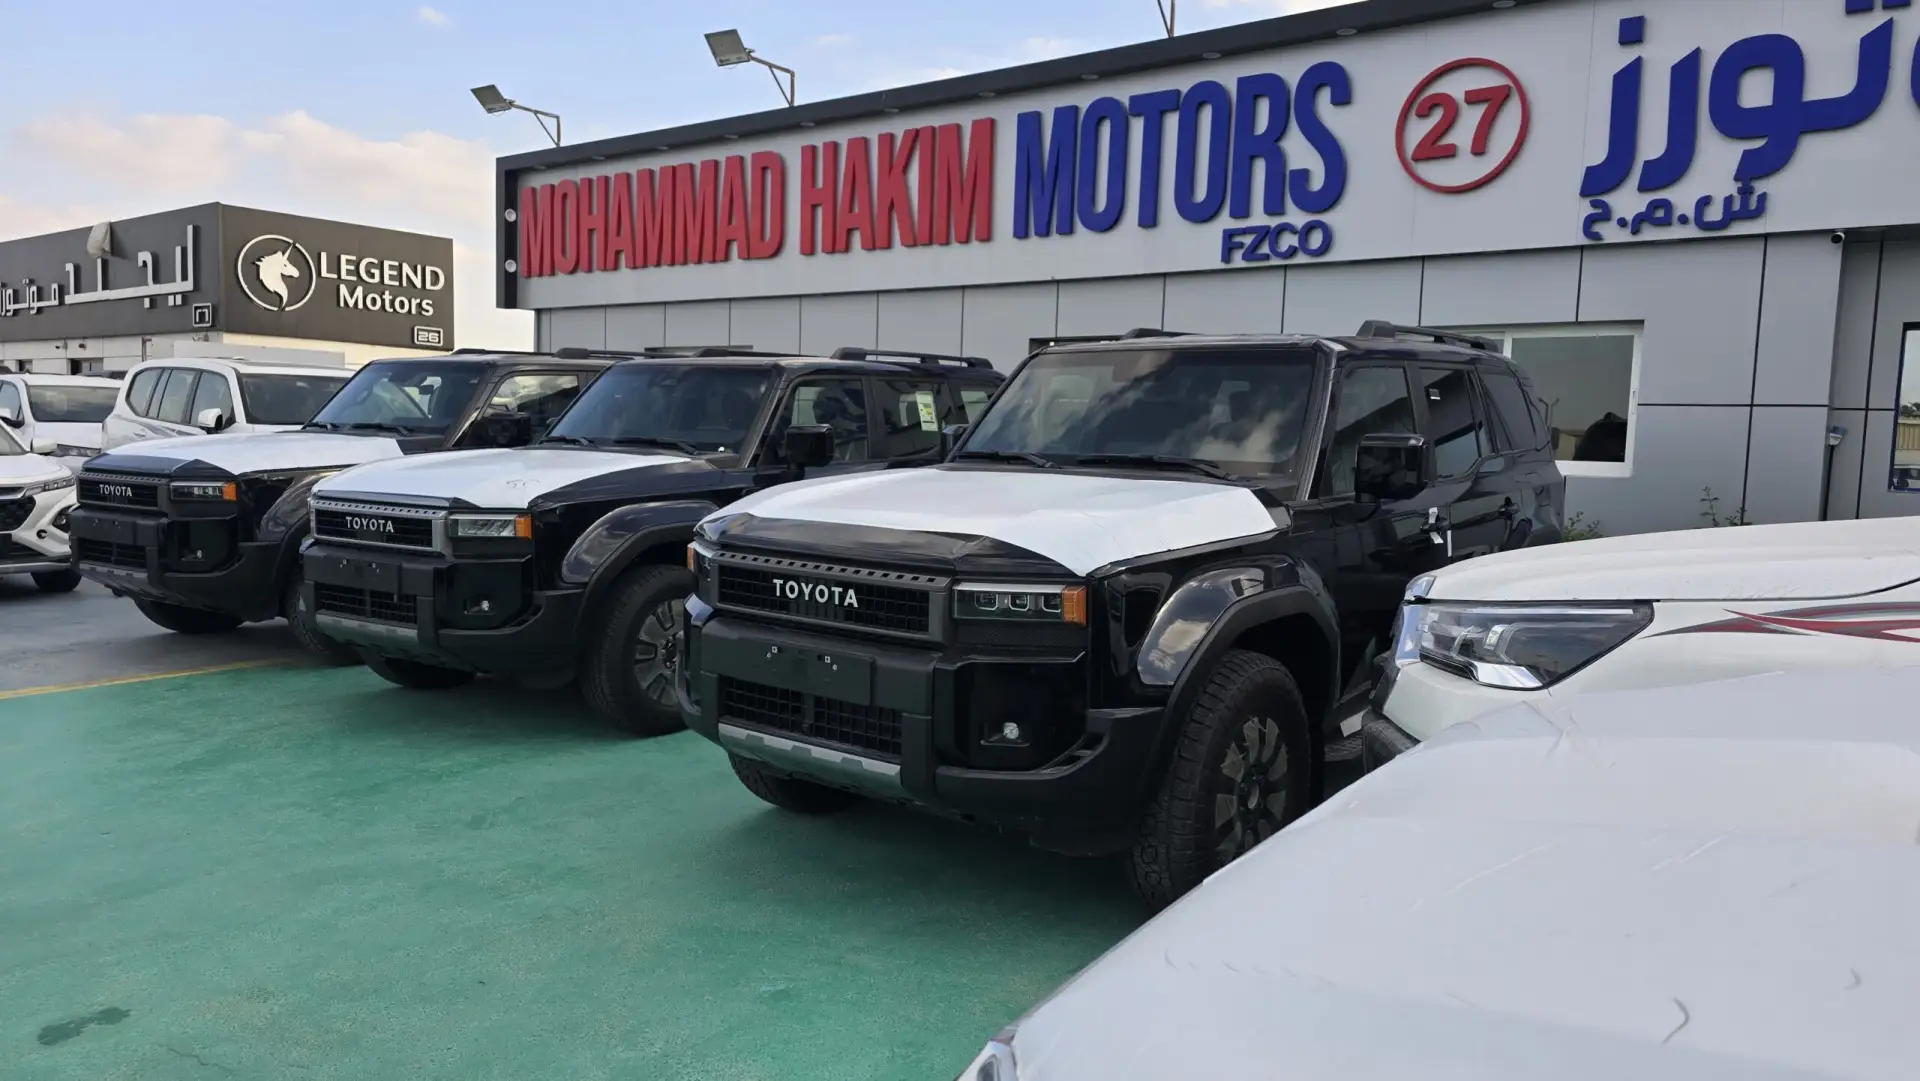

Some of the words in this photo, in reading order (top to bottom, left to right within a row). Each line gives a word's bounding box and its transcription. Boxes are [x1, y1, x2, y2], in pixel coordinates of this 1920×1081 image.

[1411, 84, 1511, 161] 27
[520, 150, 785, 279] MOHAMMAD
[800, 117, 996, 255] HAKIM
[1013, 61, 1353, 239] MOTORS
[1221, 219, 1334, 264] FZCO
[319, 251, 445, 291] LEGEND
[338, 283, 434, 317] Motors
[418, 329, 439, 343] 26
[99, 483, 133, 497] TOYOTA
[345, 516, 395, 533] TOYOTA
[772, 578, 859, 608] TOYOTA
